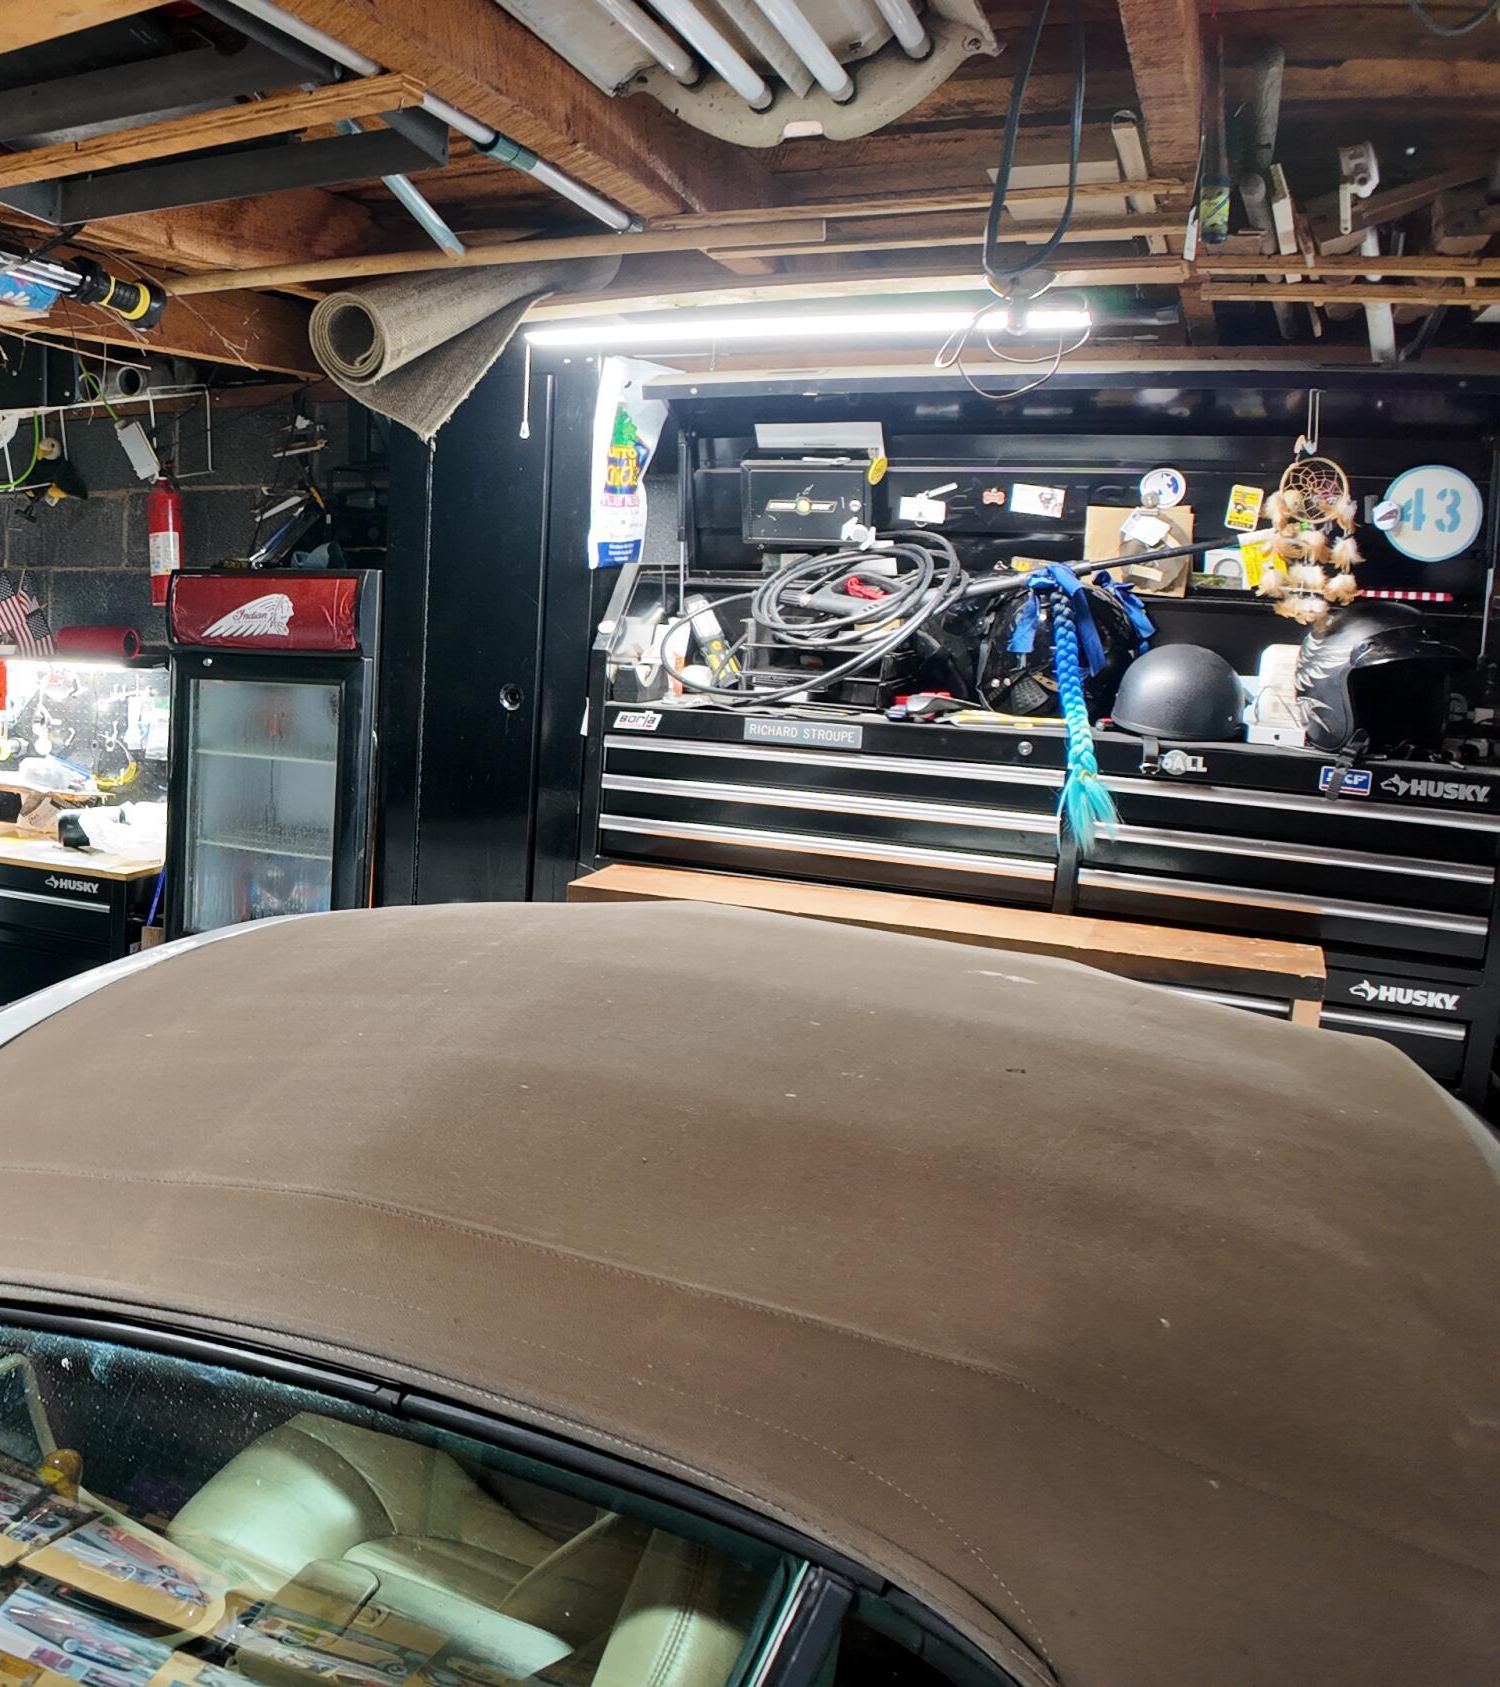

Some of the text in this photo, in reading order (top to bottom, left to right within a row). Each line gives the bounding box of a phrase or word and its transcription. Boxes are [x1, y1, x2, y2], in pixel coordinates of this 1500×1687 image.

[1399, 487, 1461, 533] 43
[749, 723, 855, 743] RICHARD STROUPE
[1410, 778, 1491, 803] HUSKY
[59, 878, 100, 894] HUSKY
[1378, 985, 1460, 1011] HUSKY
